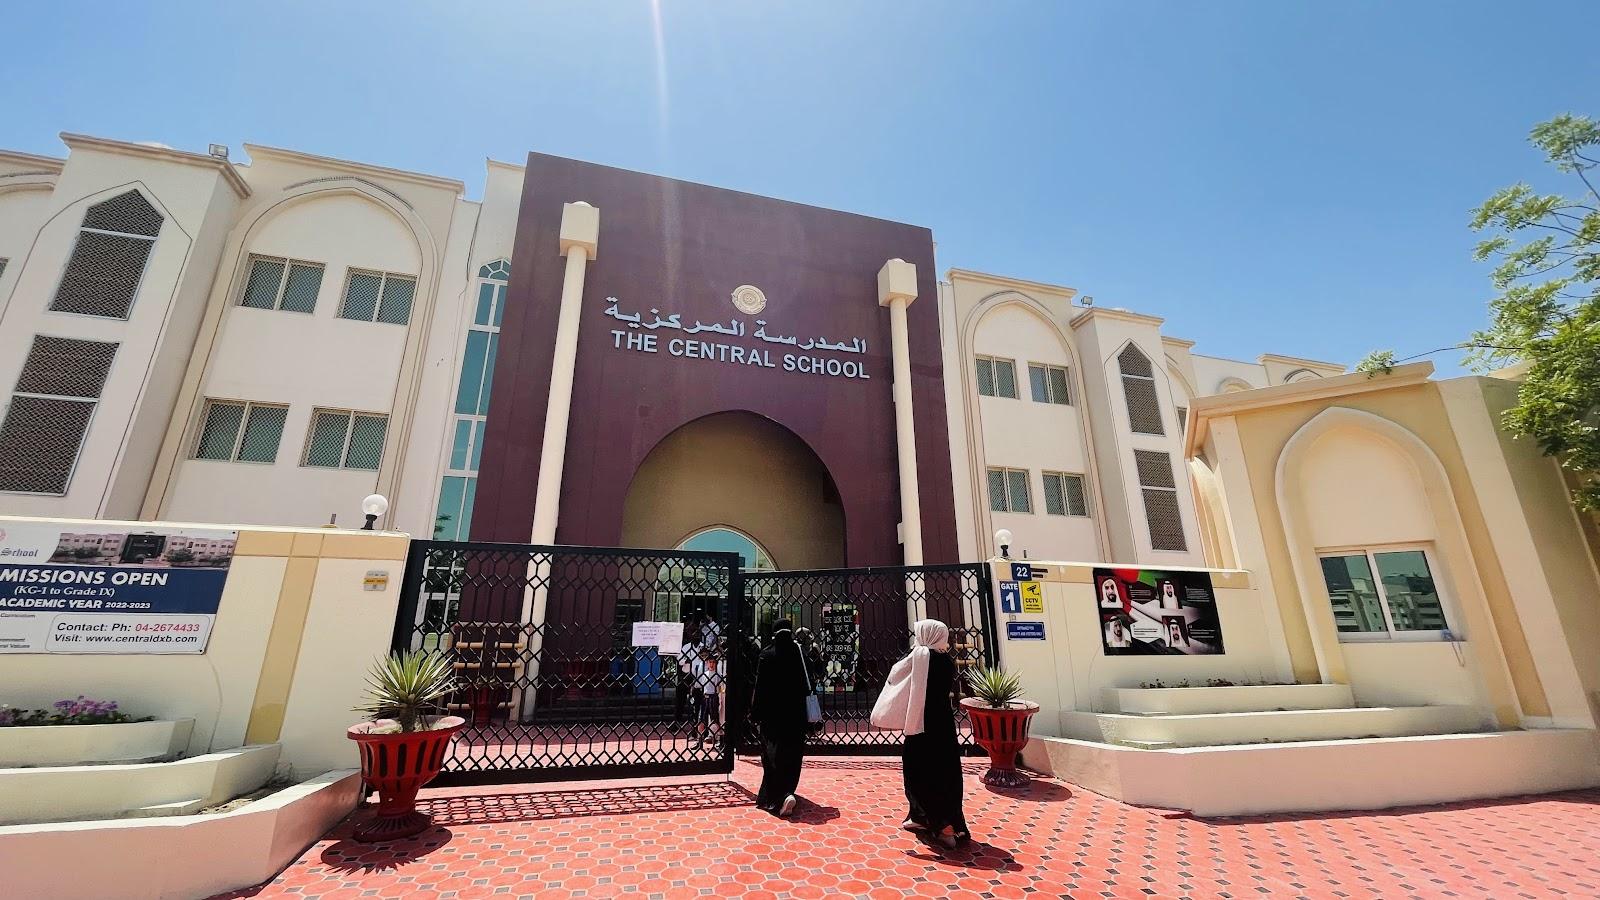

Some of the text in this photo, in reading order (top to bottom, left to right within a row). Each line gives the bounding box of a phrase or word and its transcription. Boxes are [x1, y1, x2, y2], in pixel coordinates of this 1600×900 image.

[604, 296, 867, 354] المدرسة المركزية
[610, 329, 871, 379] THE CENTRAL SCHOOL
[1, 547, 39, 557] School
[0, 568, 169, 586] MISSIONS OPEN
[1016, 566, 1029, 577] 22
[14, 585, 116, 598] (KG-1 to Grade IX)
[0, 598, 151, 609] ACADEMIC YEAR 2022-2023
[1005, 592, 1016, 611] 1
[57, 622, 200, 632] Contact: Ph: 04-2674433
[54, 633, 198, 643] Visit: www.centraldxb.com
